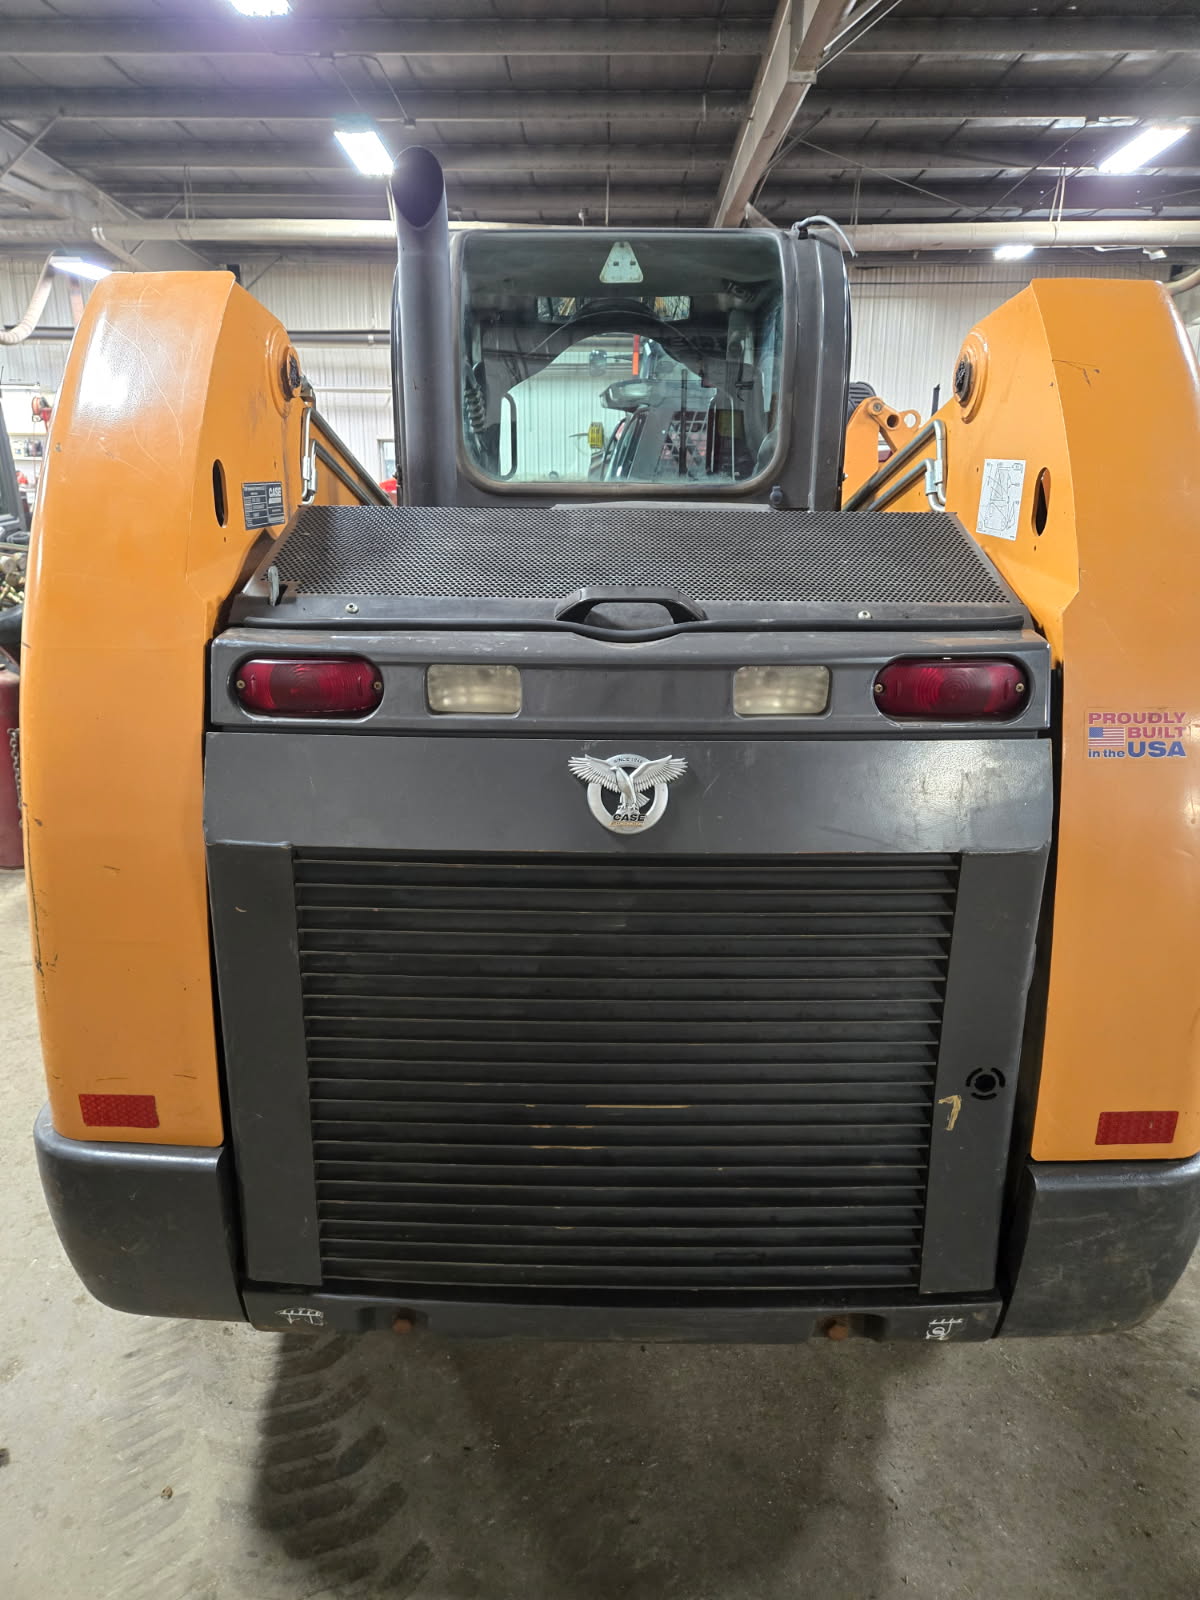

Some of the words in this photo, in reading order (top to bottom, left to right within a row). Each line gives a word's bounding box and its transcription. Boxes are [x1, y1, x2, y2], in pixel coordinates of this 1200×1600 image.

[268, 487, 282, 498] CASE
[1088, 712, 1186, 724] PROUDLY
[1127, 727, 1185, 738] BUILT
[1088, 749, 1100, 757] in
[1103, 749, 1125, 757] the
[1127, 741, 1186, 757] USA
[613, 813, 645, 821] CASE
